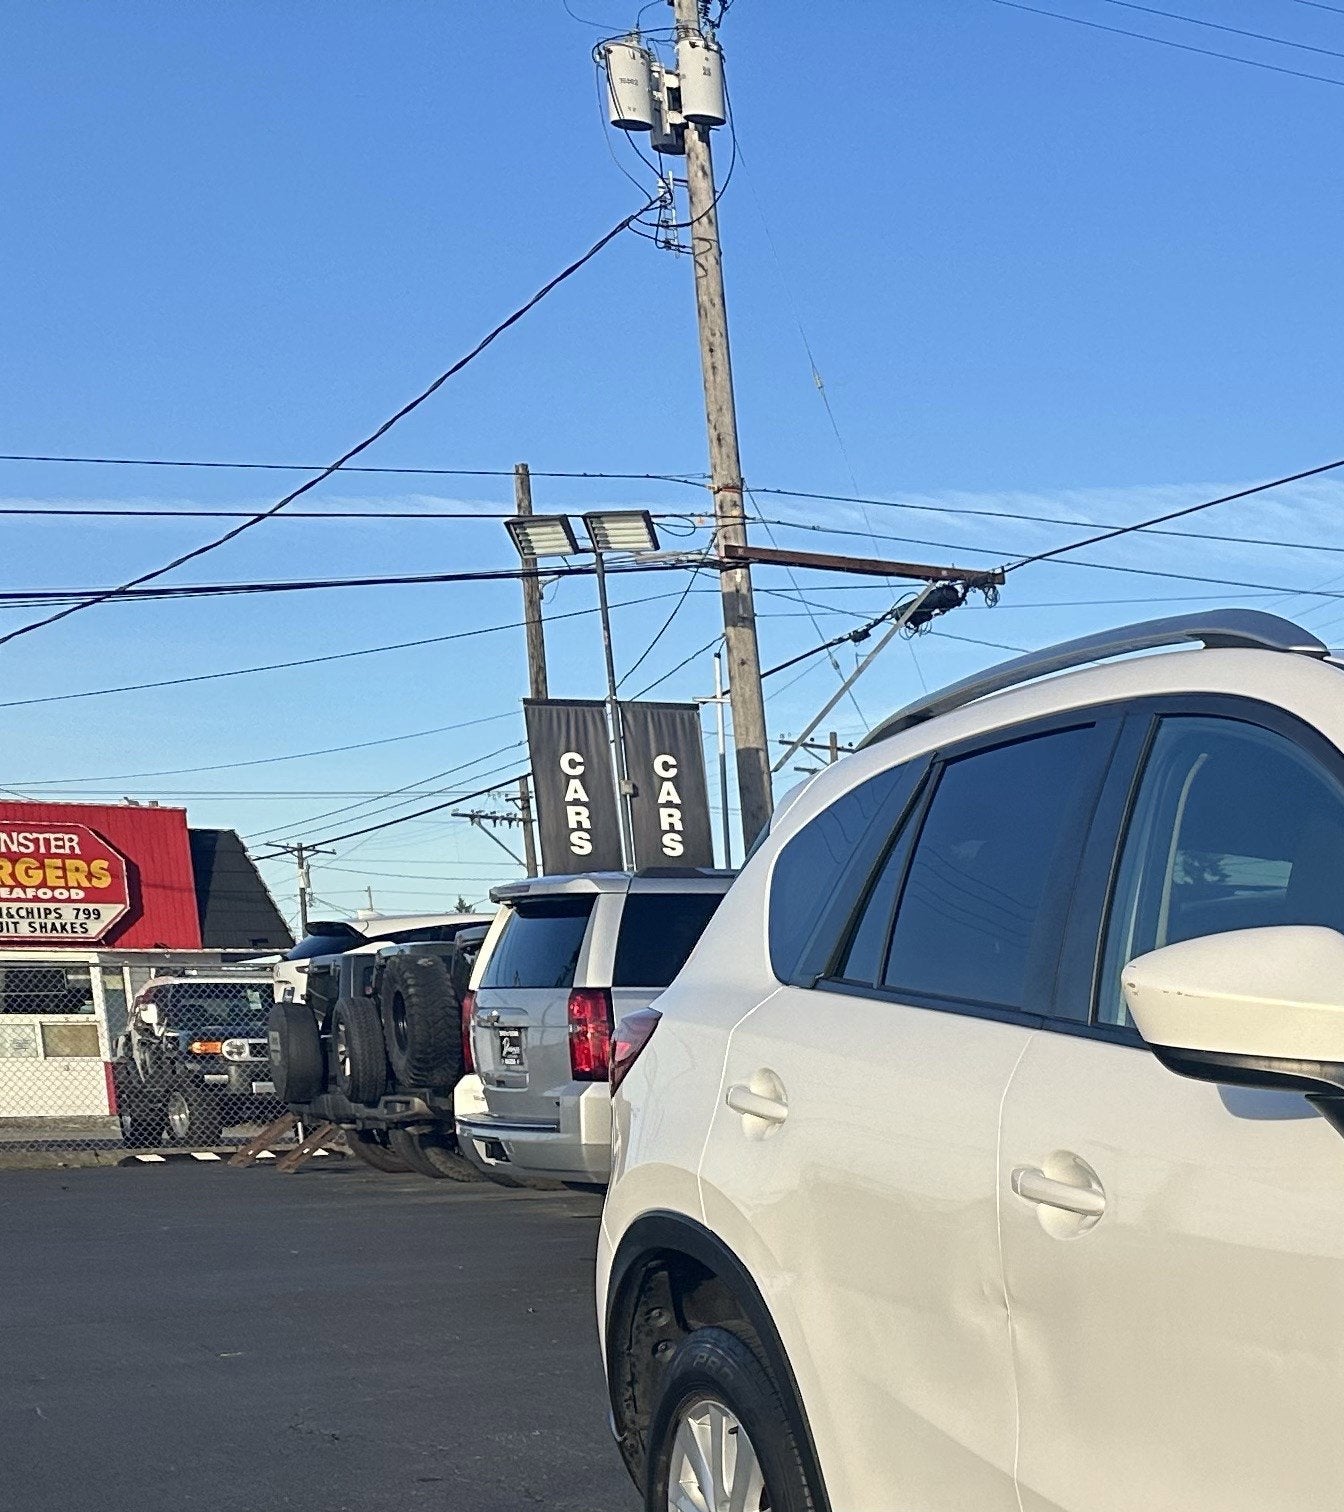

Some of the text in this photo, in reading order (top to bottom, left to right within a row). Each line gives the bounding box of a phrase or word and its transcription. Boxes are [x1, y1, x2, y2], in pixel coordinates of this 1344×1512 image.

[559, 751, 593, 856] CARS
[653, 754, 684, 857] CARS
[0, 906, 101, 920] &CHIPS 799
[28, 921, 89, 934] SHAKES
